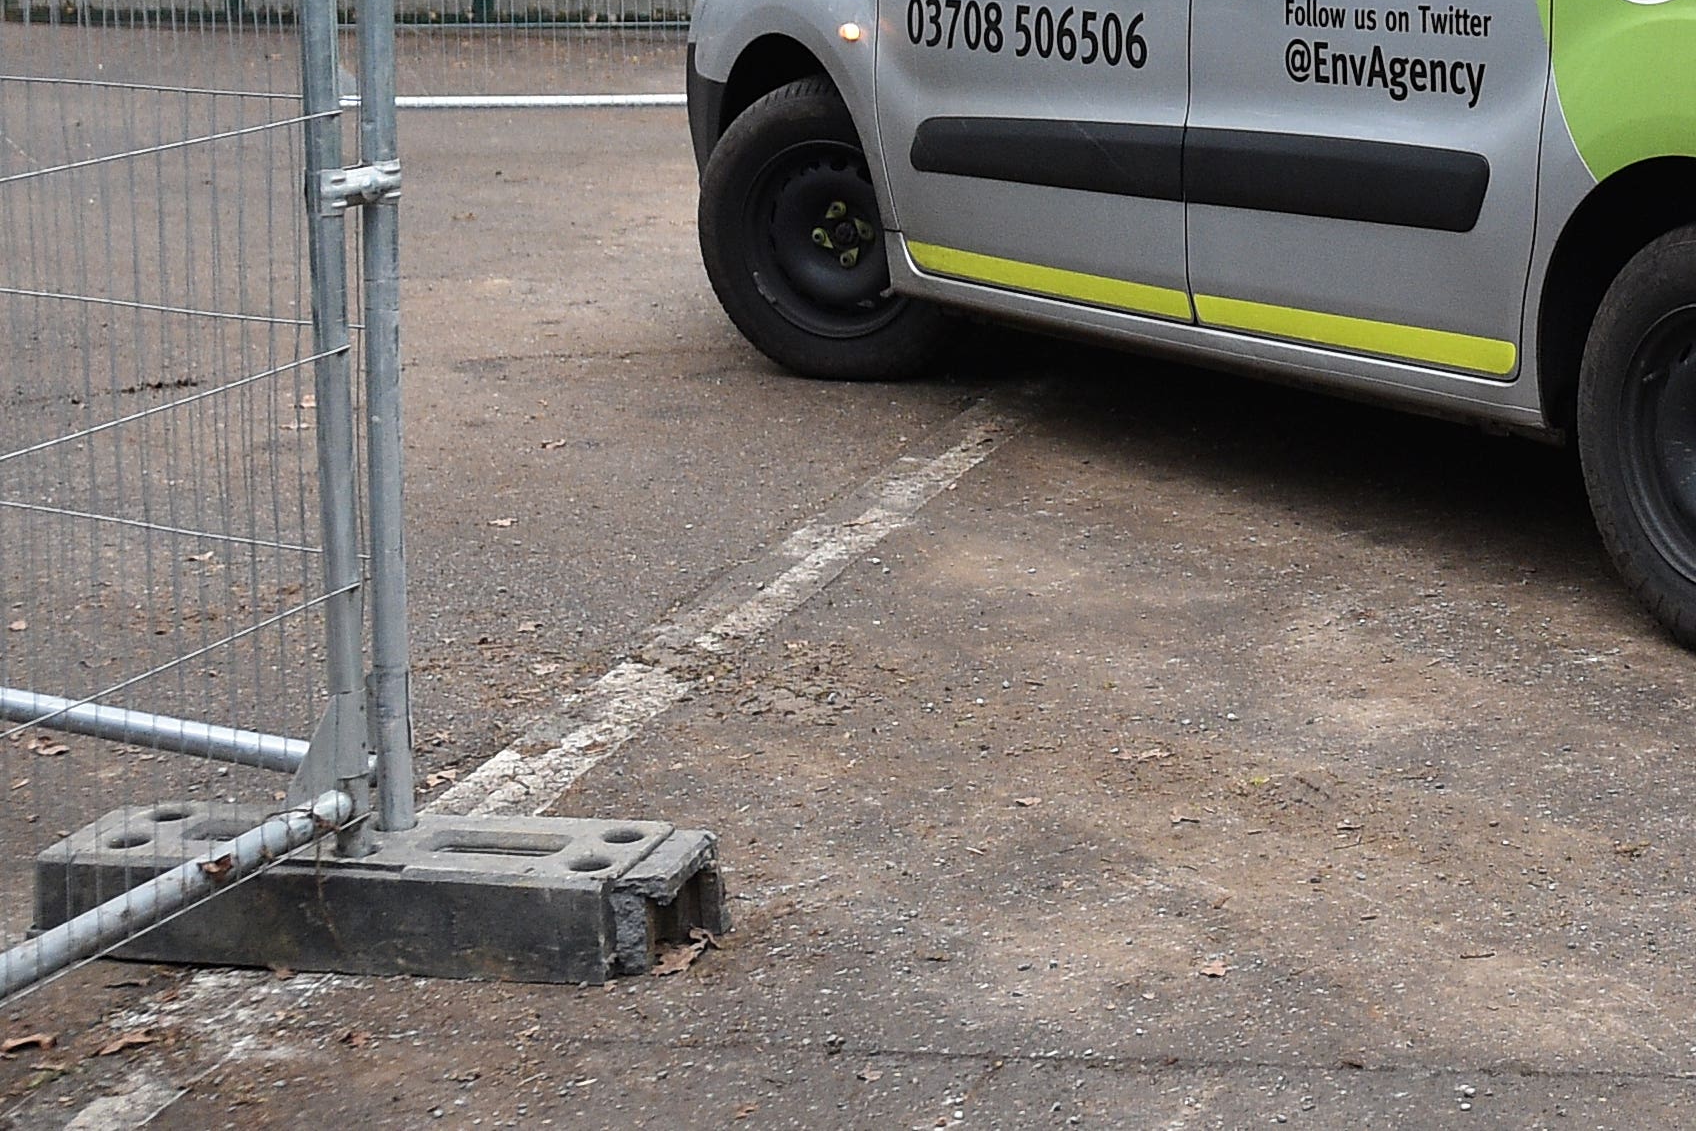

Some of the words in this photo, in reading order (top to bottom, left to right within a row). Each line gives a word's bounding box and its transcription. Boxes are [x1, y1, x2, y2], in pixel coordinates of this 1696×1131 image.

[1015, 5, 1147, 69] 506506
[1355, 8, 1377, 31] us
[1385, 9, 1409, 33] on
[1418, 5, 1492, 37] Twitter
[1285, 38, 1486, 109] @EnvAgency
